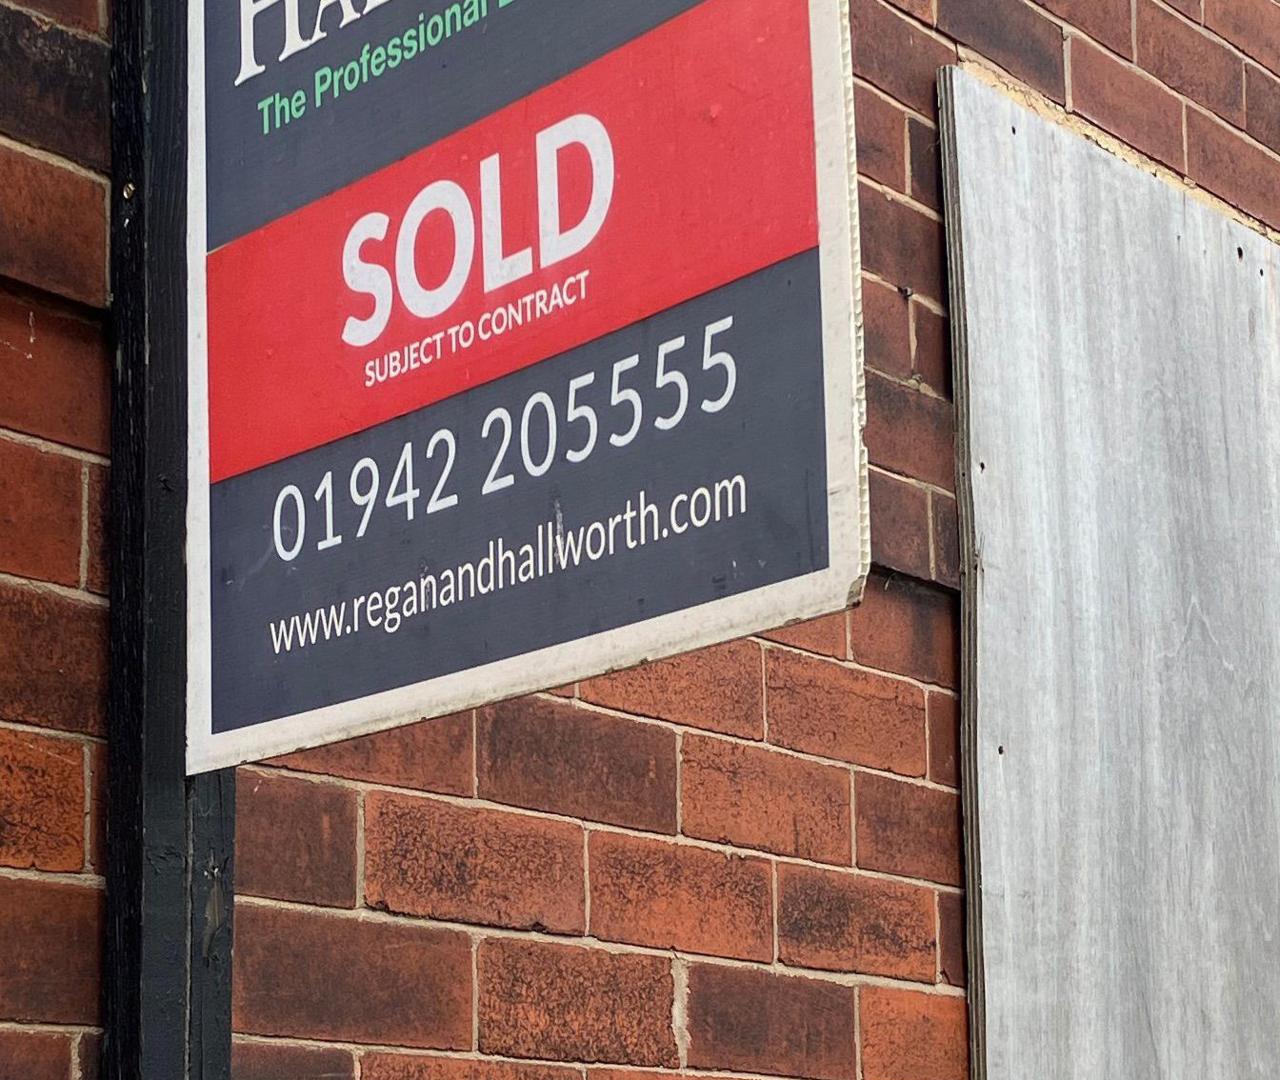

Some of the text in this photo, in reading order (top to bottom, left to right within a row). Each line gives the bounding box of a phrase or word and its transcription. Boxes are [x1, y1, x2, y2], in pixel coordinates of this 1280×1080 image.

[257, 87, 306, 134] The
[341, 113, 614, 347] SOLD
[364, 270, 590, 387] SUBJECT TO CONTRACT
[273, 316, 738, 562] 01942 205555
[269, 474, 748, 655] www.reganandhallworth.com
